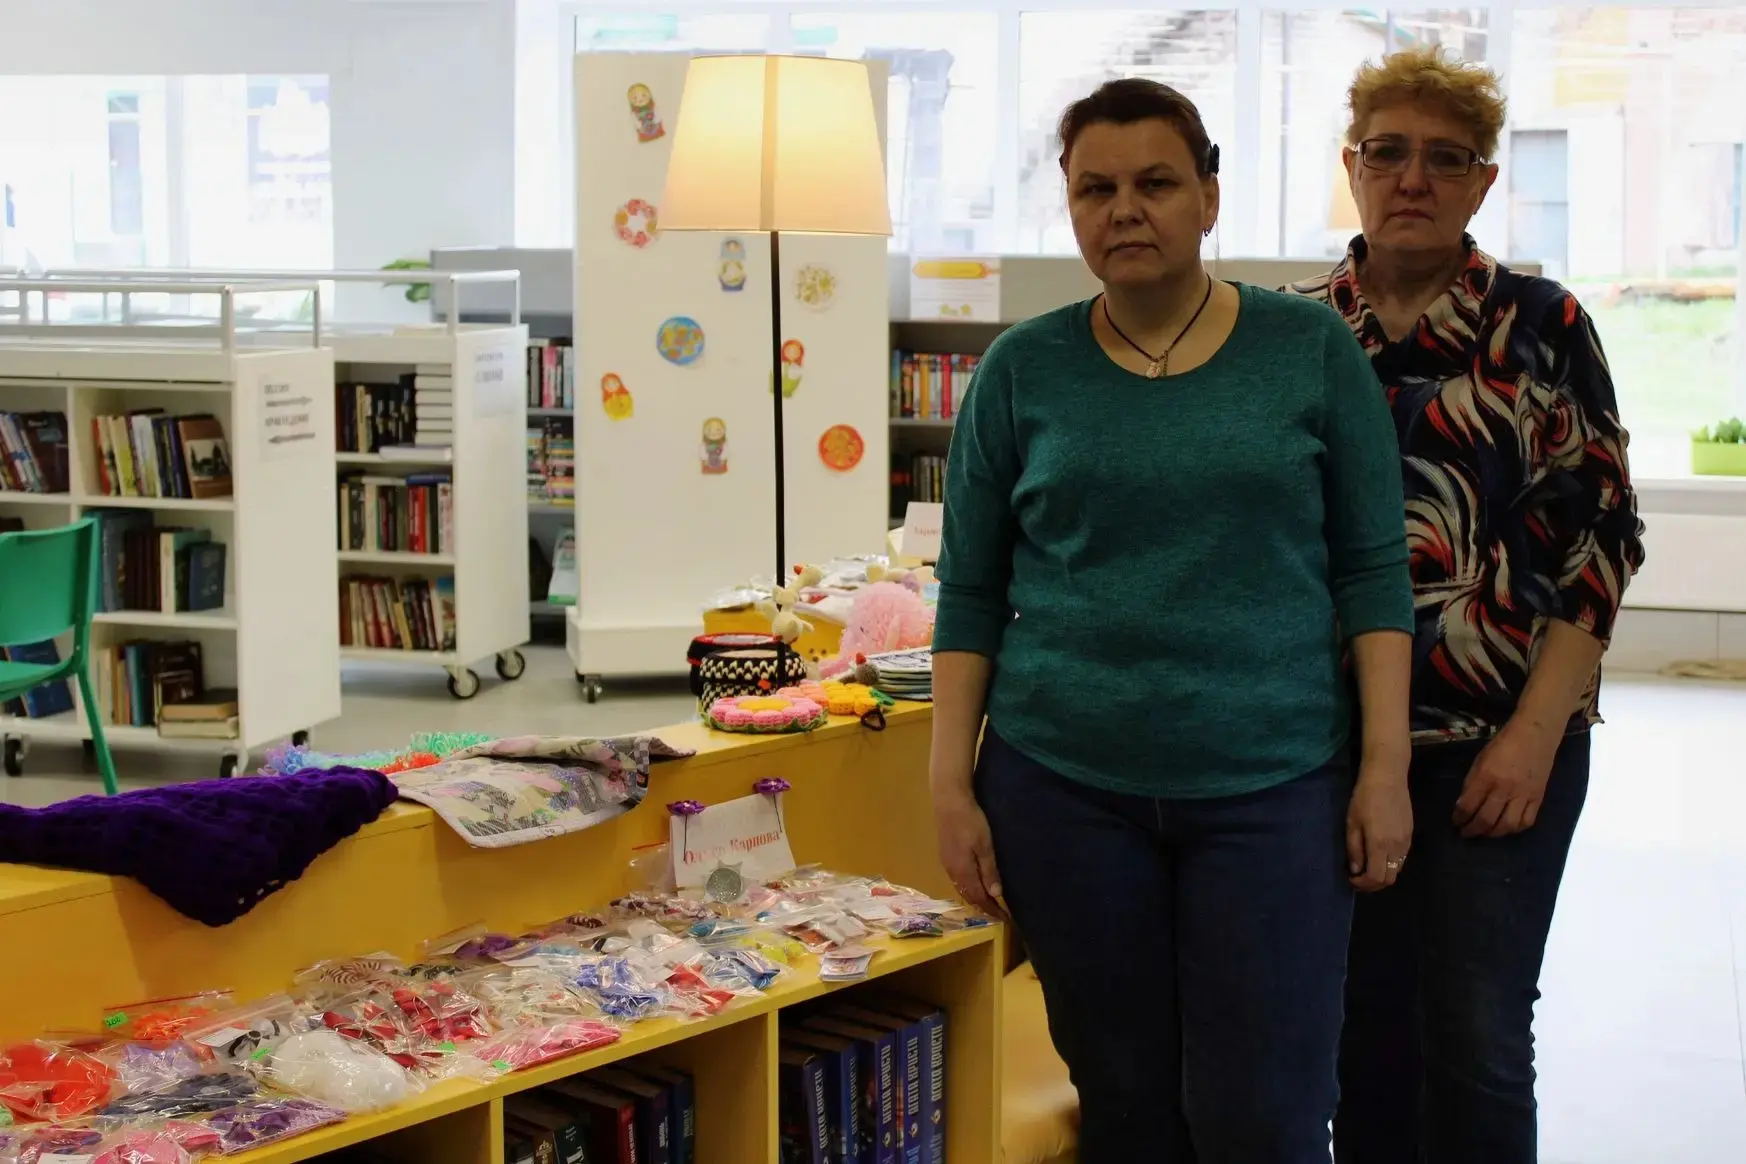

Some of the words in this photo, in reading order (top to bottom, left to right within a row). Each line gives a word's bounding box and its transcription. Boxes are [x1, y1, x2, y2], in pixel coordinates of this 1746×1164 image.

[730, 830, 780, 852] Карпова
[907, 1036, 918, 1081] КРИСТИ
[931, 1025, 943, 1068] КРИСТИ
[881, 1044, 891, 1089] КРИСТИ
[907, 1081, 919, 1115] АГАТА
[931, 1068, 943, 1102] АГАТА
[881, 1089, 892, 1124] АГАТА
